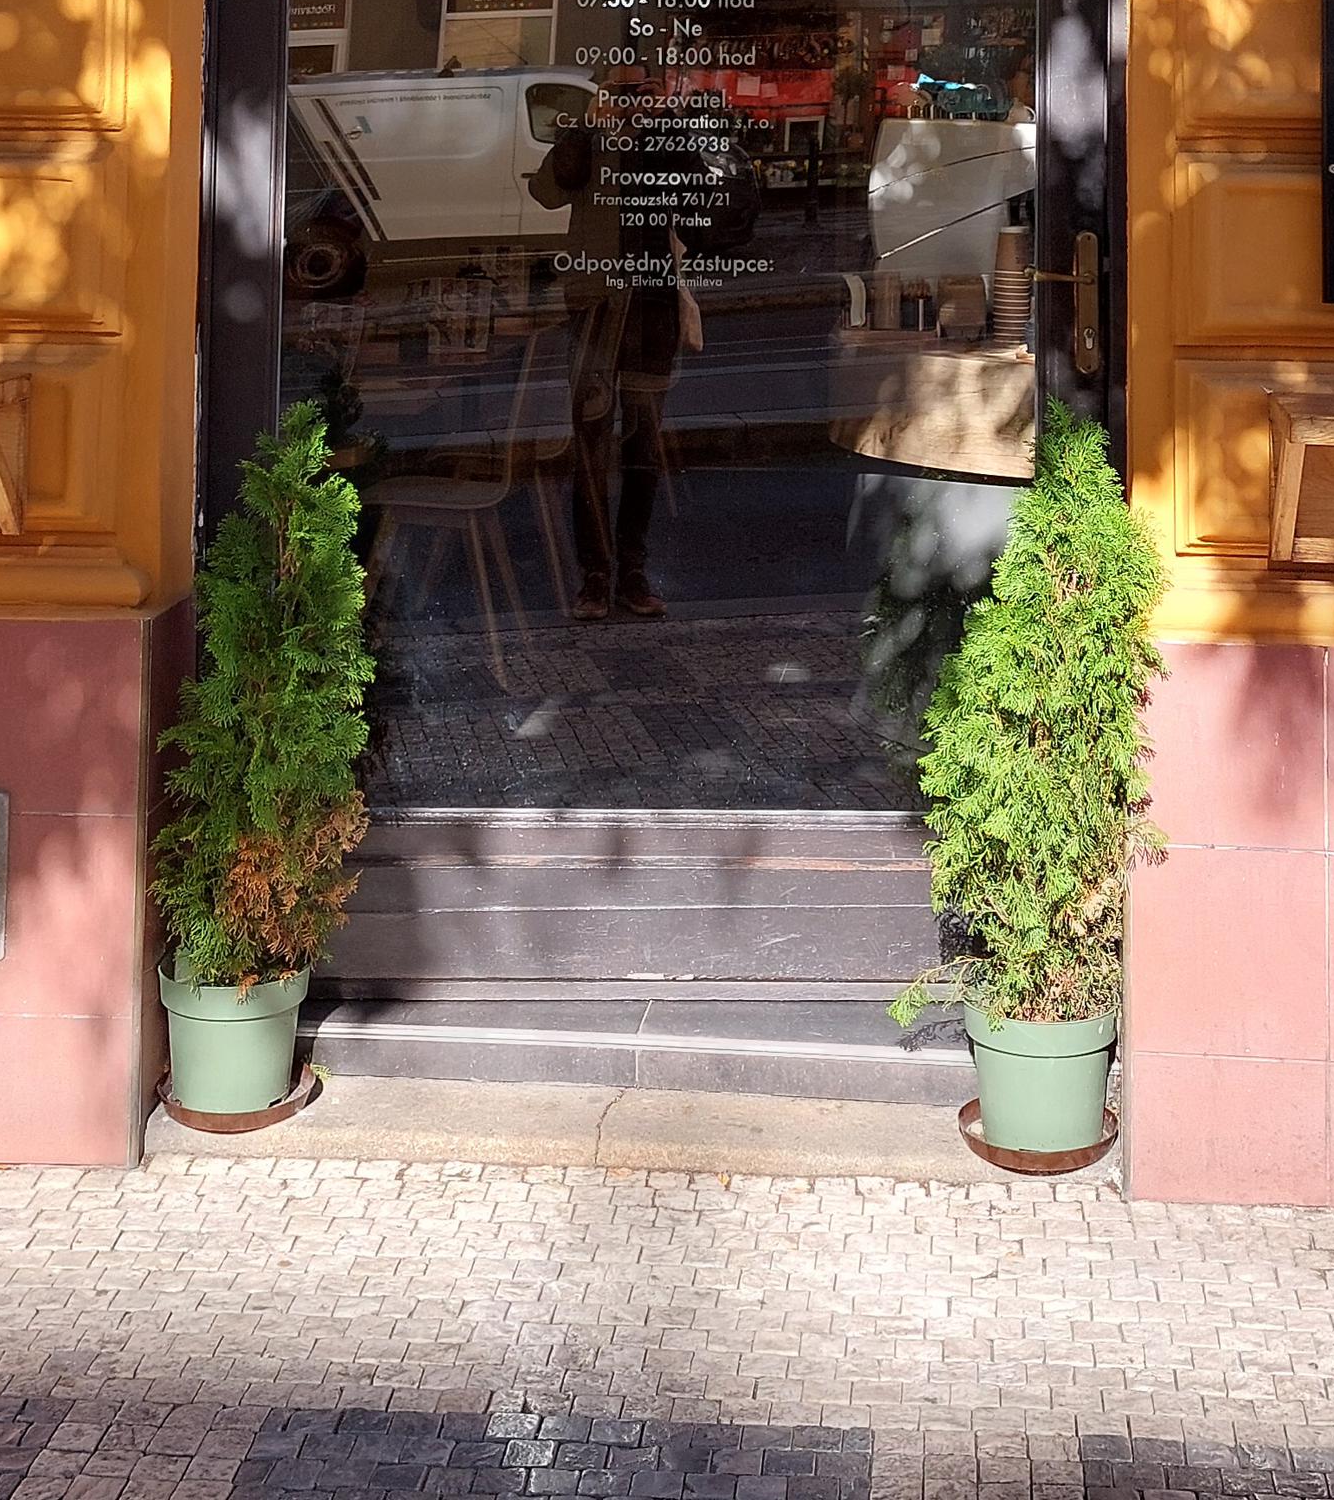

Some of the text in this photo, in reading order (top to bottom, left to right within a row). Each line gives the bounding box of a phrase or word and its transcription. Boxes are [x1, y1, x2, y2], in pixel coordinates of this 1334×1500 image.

[629, 18, 654, 37] So
[673, 19, 703, 37] Ne
[575, 46, 636, 66] 09:00
[656, 47, 712, 66] 18:00
[719, 46, 756, 66] hod
[598, 89, 733, 109] Provozovatel:
[556, 113, 775, 132] Cz Unity Corporation s.r.o.
[600, 132, 730, 152] IČO: 27626938
[593, 192, 730, 209] Francouzská 761/21
[620, 213, 712, 227] 120 00 Praha
[554, 251, 775, 277] Odpovědný zástupce:
[632, 275, 663, 287] Elvira
